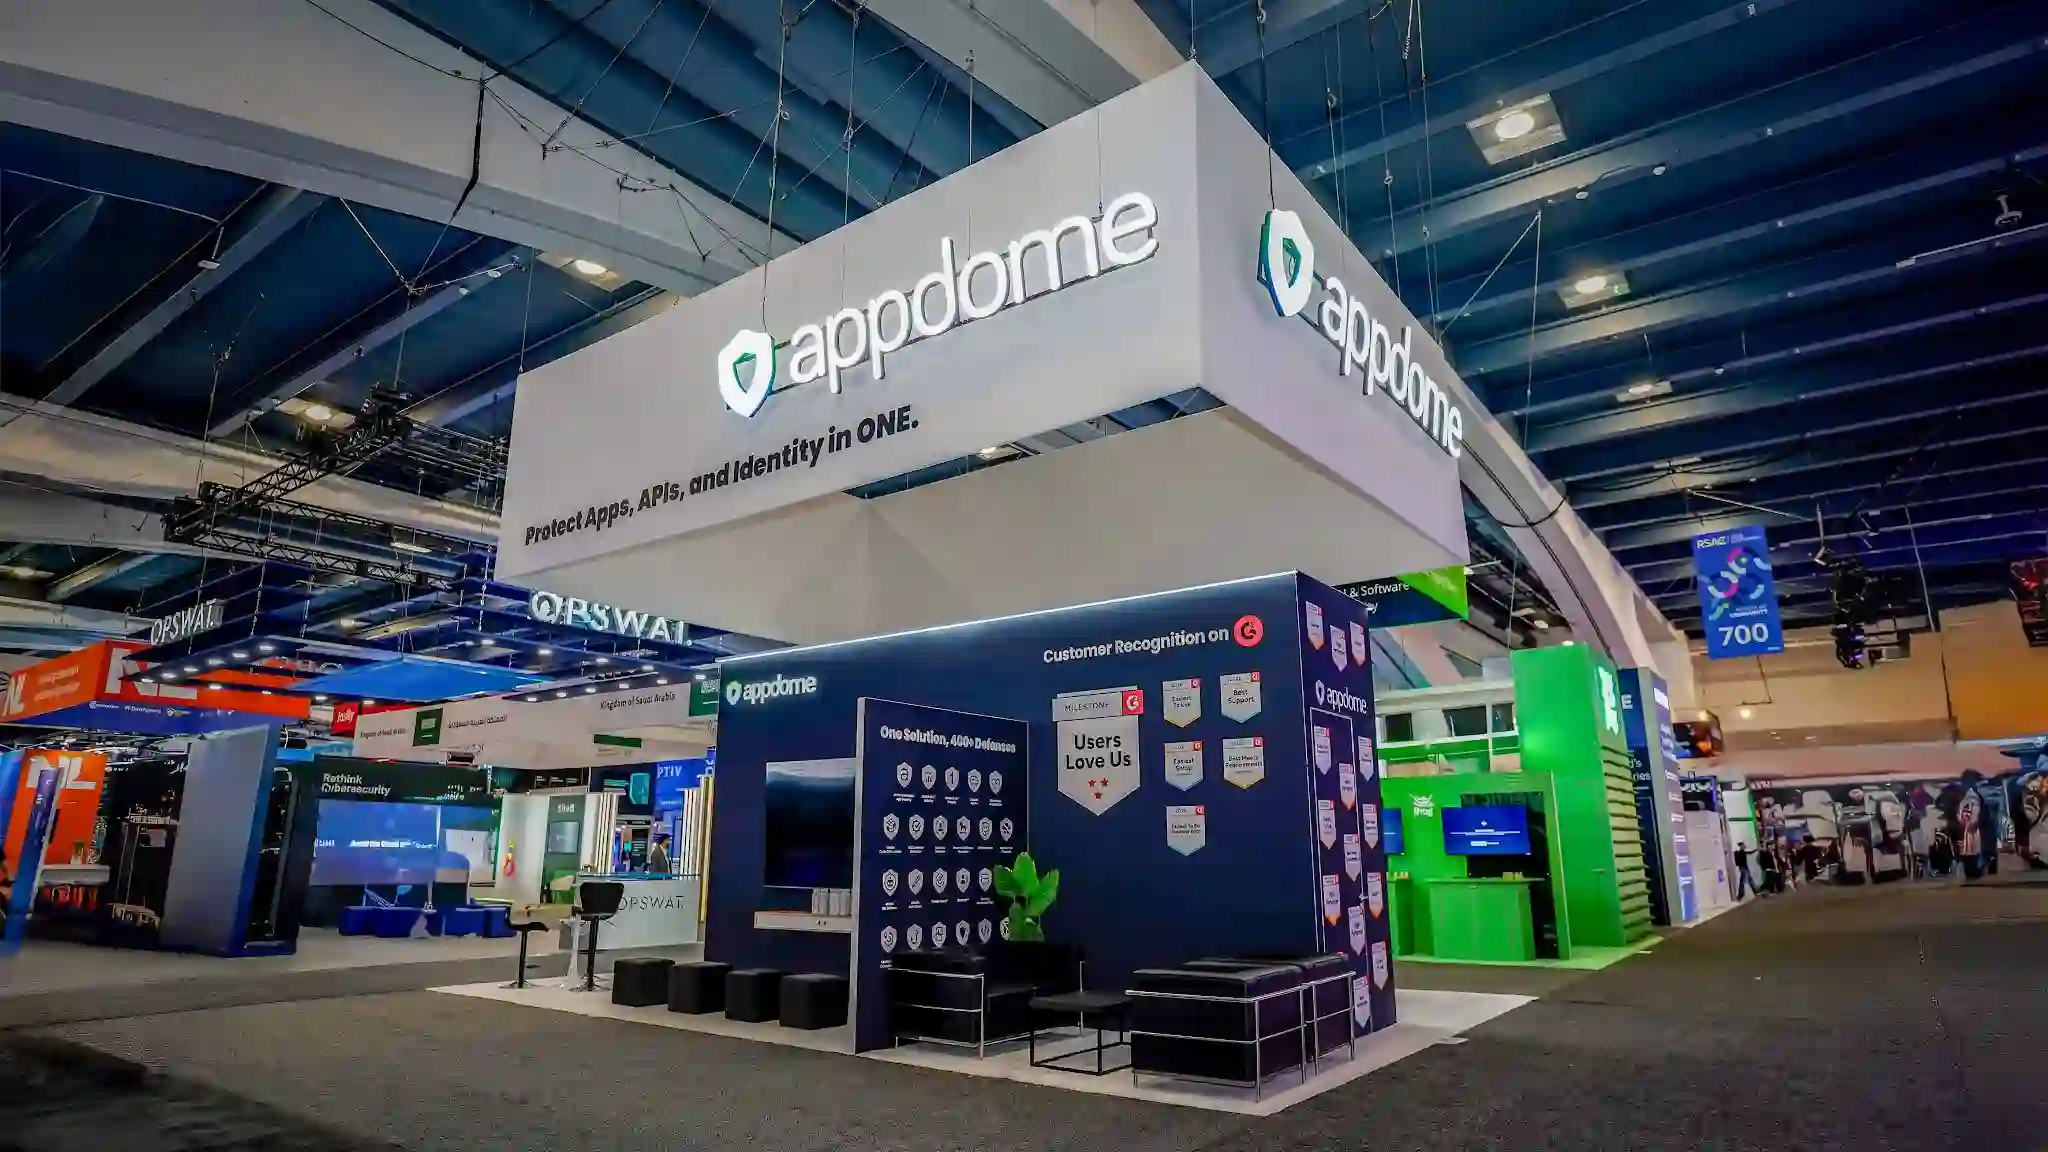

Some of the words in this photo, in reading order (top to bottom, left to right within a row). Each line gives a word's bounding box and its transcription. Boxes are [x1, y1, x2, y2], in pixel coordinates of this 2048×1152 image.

[789, 192, 1159, 394] appdome
[1319, 276, 1463, 458] appdome
[525, 511, 582, 545] Protect
[584, 498, 634, 531] Apps,
[637, 480, 685, 512] APIs,
[689, 462, 729, 494] and
[733, 436, 825, 483] Identity
[828, 426, 852, 454] in
[856, 404, 919, 444] ONE.
[1350, 587, 1359, 598] &
[1360, 583, 1410, 597] Software
[1043, 641, 1113, 664] Customer
[1114, 629, 1206, 654] Recognition
[1208, 626, 1229, 642] on
[1718, 622, 1769, 646] 700
[743, 673, 817, 704] appdome
[1326, 686, 1368, 714] appdome
[880, 724, 903, 740] One
[903, 728, 949, 748] Solution,
[950, 734, 974, 747] 400+
[975, 737, 1016, 753] Defenses
[1074, 734, 1121, 750] Users
[1066, 754, 1105, 770] Love
[1110, 751, 1131, 767] Us
[323, 772, 363, 785] Rethink
